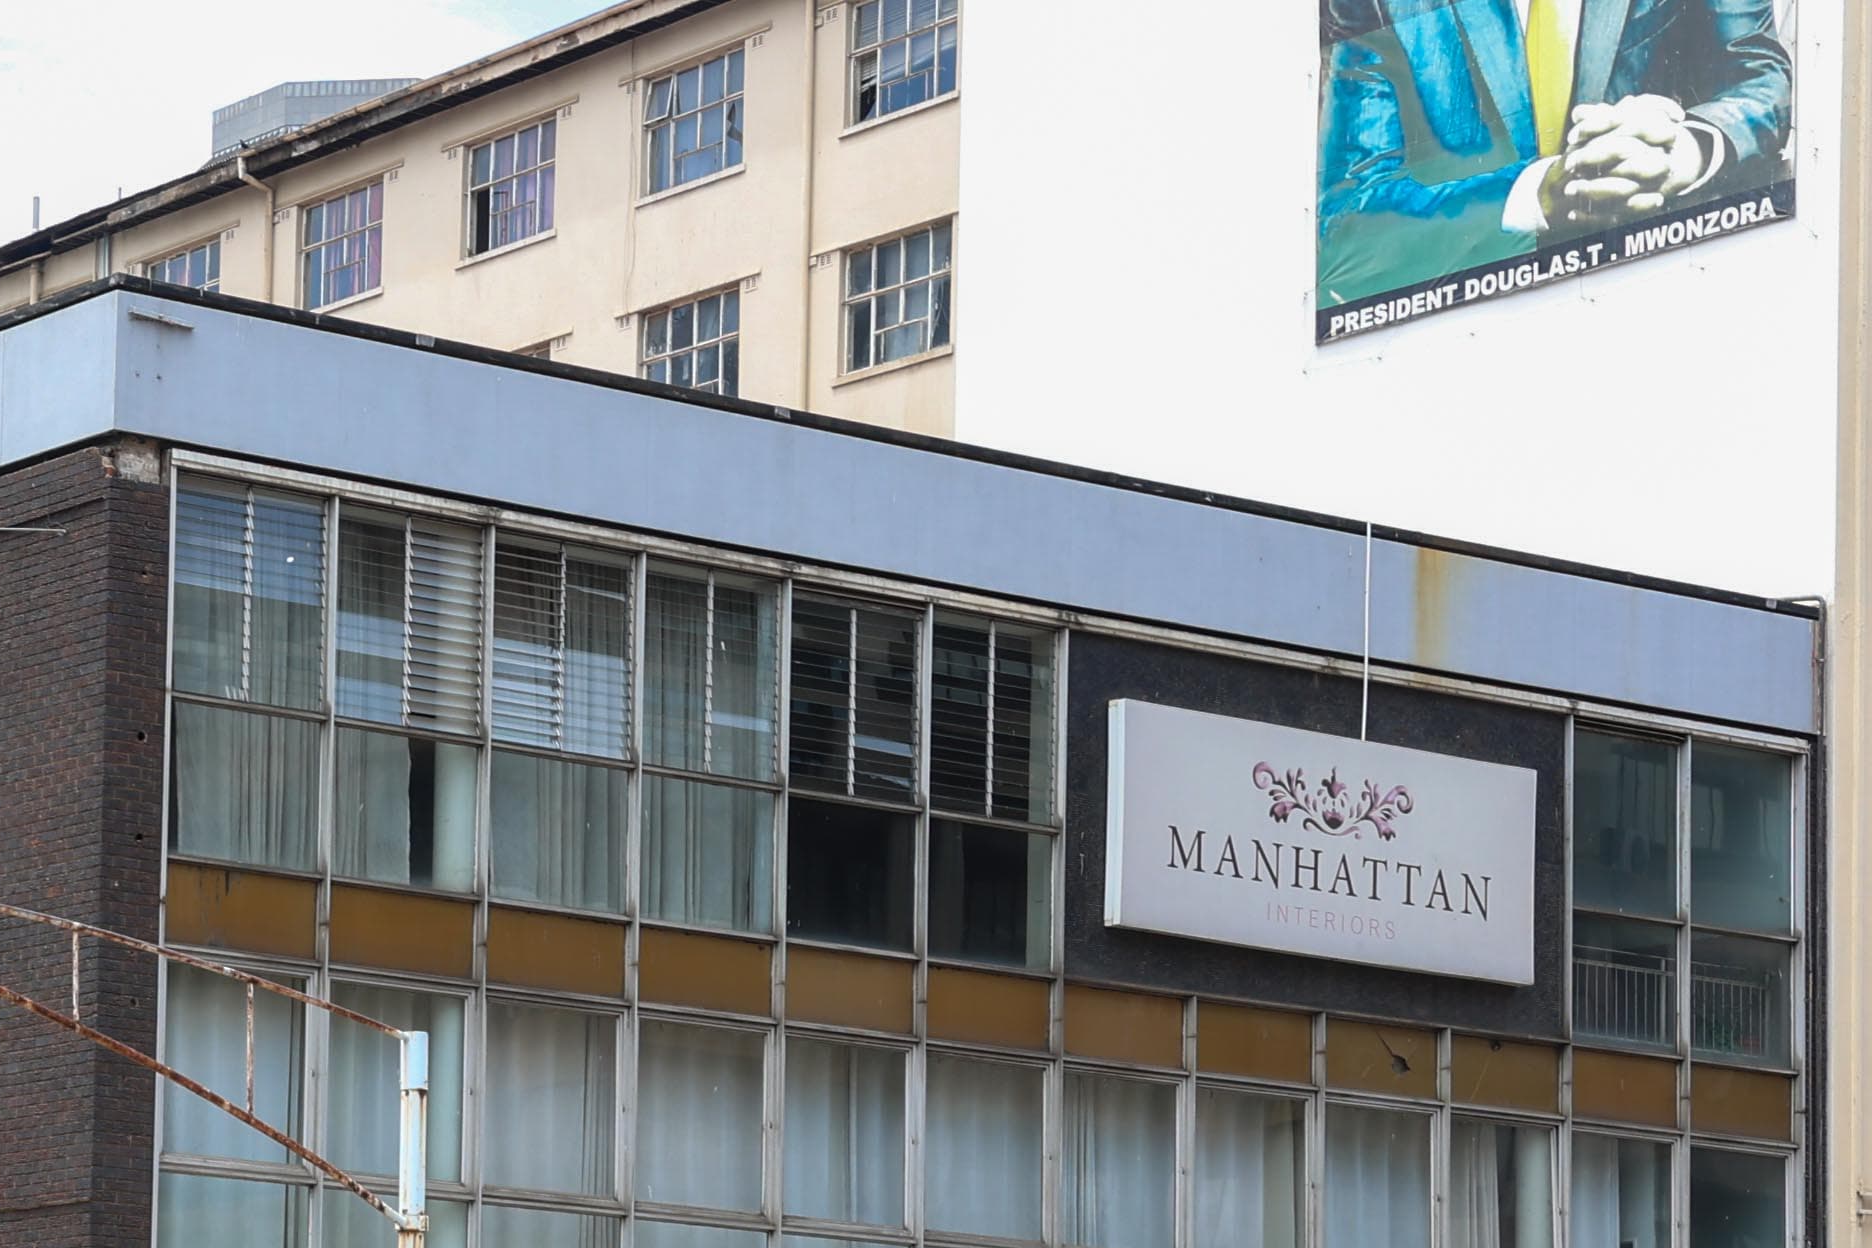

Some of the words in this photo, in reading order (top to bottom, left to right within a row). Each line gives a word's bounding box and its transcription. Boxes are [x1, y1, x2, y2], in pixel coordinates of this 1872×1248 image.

[1330, 284, 1458, 337] PRESIDENT
[1624, 197, 1777, 260] MWONZORA
[1167, 825, 1492, 922] MANHATTAN
[1266, 902, 1396, 940] INTERIORS
